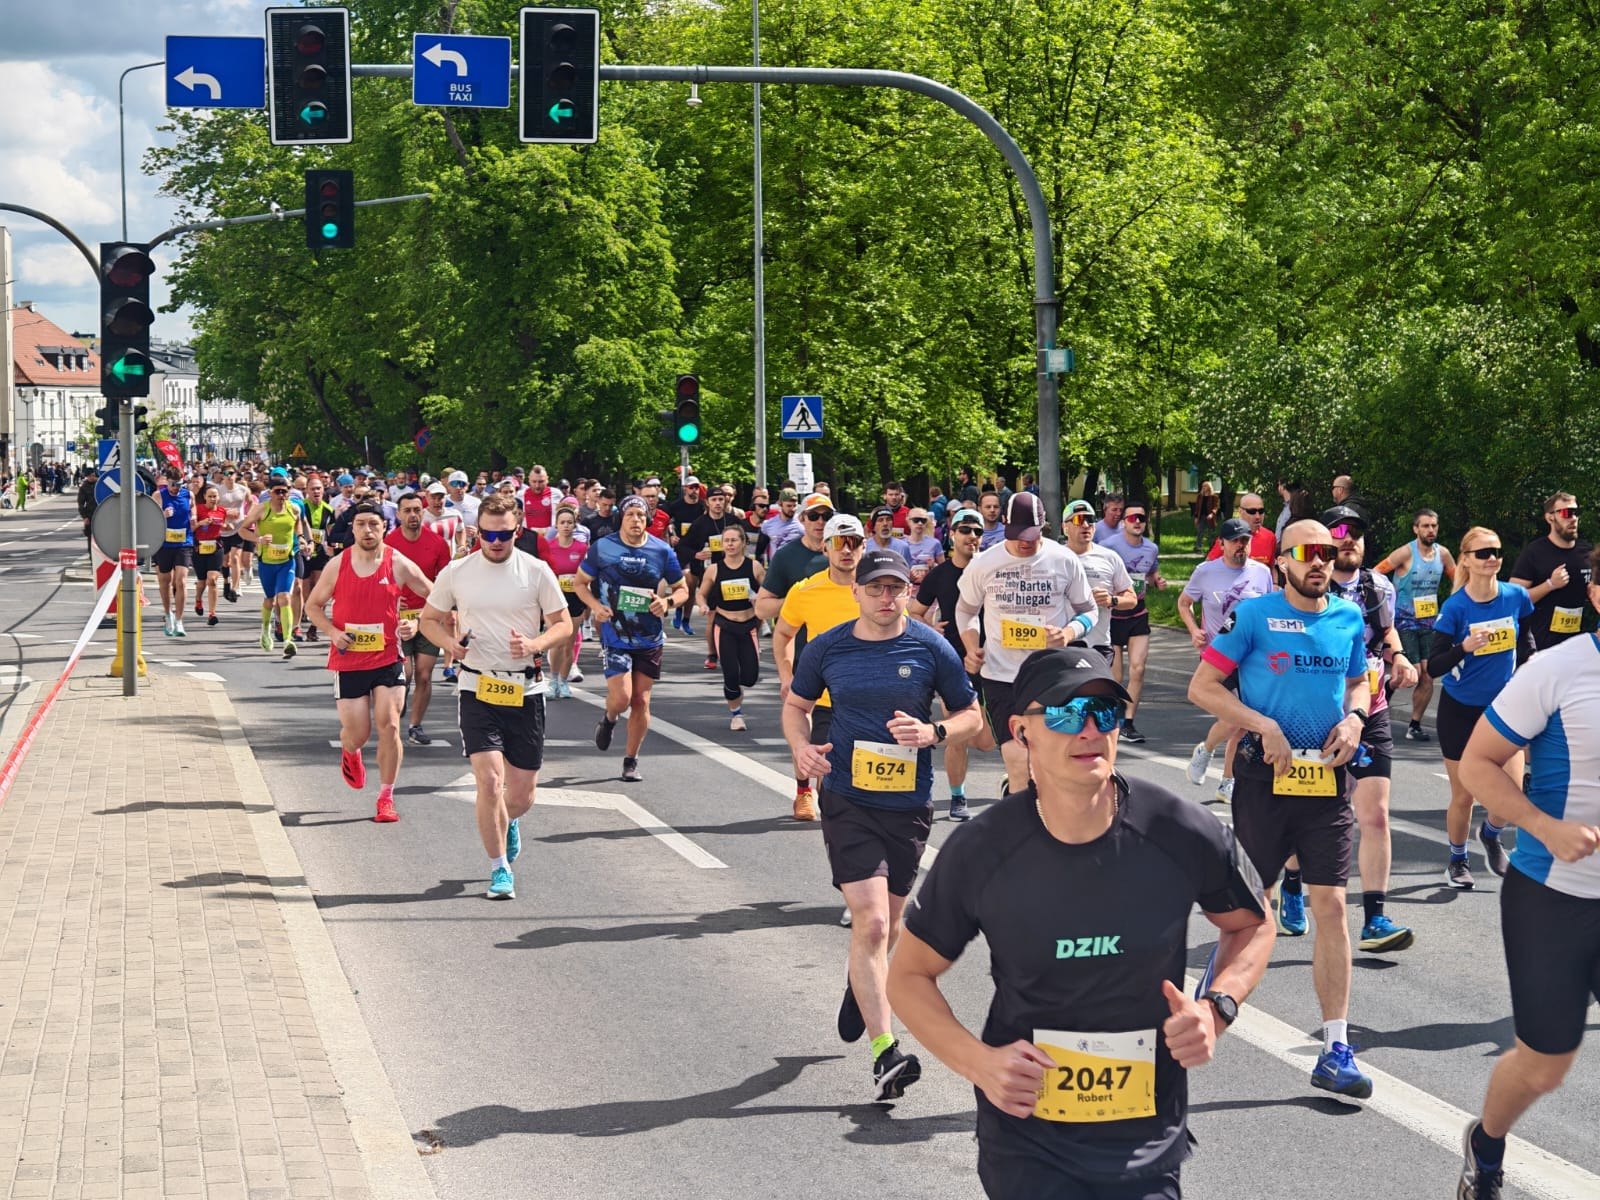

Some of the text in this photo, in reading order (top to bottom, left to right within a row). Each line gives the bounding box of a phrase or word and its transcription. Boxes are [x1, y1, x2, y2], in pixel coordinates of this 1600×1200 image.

[450, 83, 472, 92] BUS
[449, 92, 472, 102] TAXI
[1020, 580, 1053, 592] Bartek
[1015, 592, 1051, 608] biegać
[1280, 620, 1304, 630] SMT
[1009, 627, 1037, 638] 1890
[1488, 630, 1508, 643] 012
[486, 683, 515, 695] 2398
[866, 761, 906, 776] 1674
[1287, 766, 1324, 779] 2011
[1057, 1065, 1133, 1091] 2047
[1077, 1093, 1114, 1102] Robert
